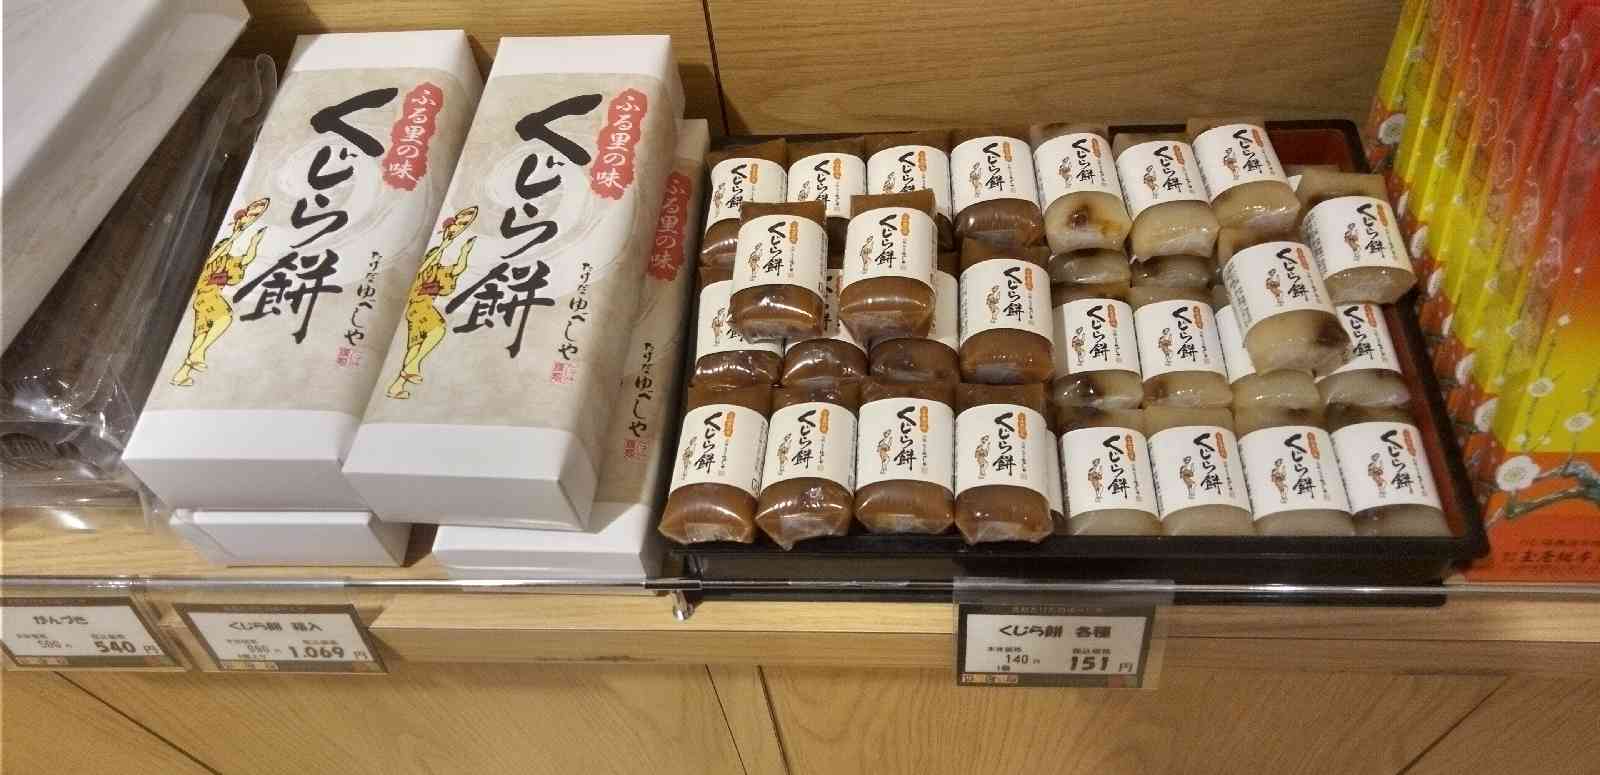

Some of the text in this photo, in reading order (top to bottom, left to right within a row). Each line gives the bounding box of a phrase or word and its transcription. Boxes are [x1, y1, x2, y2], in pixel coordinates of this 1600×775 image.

[389, 89, 438, 182] ふる里の味
[597, 98, 642, 190] ふる里の味
[1072, 138, 1096, 185] くじら餅
[1233, 129, 1263, 175] くじら餅
[983, 142, 1005, 192] くじら餅
[1154, 145, 1183, 193] くじら餅
[233, 87, 399, 345] くじら餅
[445, 93, 604, 359] くじら餅
[650, 178, 685, 271] ふる里の味
[874, 213, 899, 269] くじら餅
[1357, 203, 1386, 259] くじら餅
[762, 221, 787, 277] くじら餅
[1276, 247, 1310, 302] くじら餅
[1003, 266, 1025, 322] くじら餅
[1086, 304, 1111, 362] くじら餅
[1172, 306, 1199, 362] くじら餅
[1343, 305, 1375, 360] くじら餅
[694, 411, 723, 474] くじら餅
[791, 409, 817, 469] くじら餅
[894, 406, 918, 471] くじら餅
[992, 412, 1017, 477] くじら餅
[1193, 432, 1223, 495] くじら餅
[1284, 432, 1317, 499] くじら餅
[1380, 429, 1415, 495] くじら餅
[1102, 434, 1131, 500] くじら餅
[94, 641, 136, 653] 540
[999, 625, 1112, 638] くじら餅 各種
[1006, 654, 1029, 664] 140
[1069, 656, 1133, 672] 151 円
